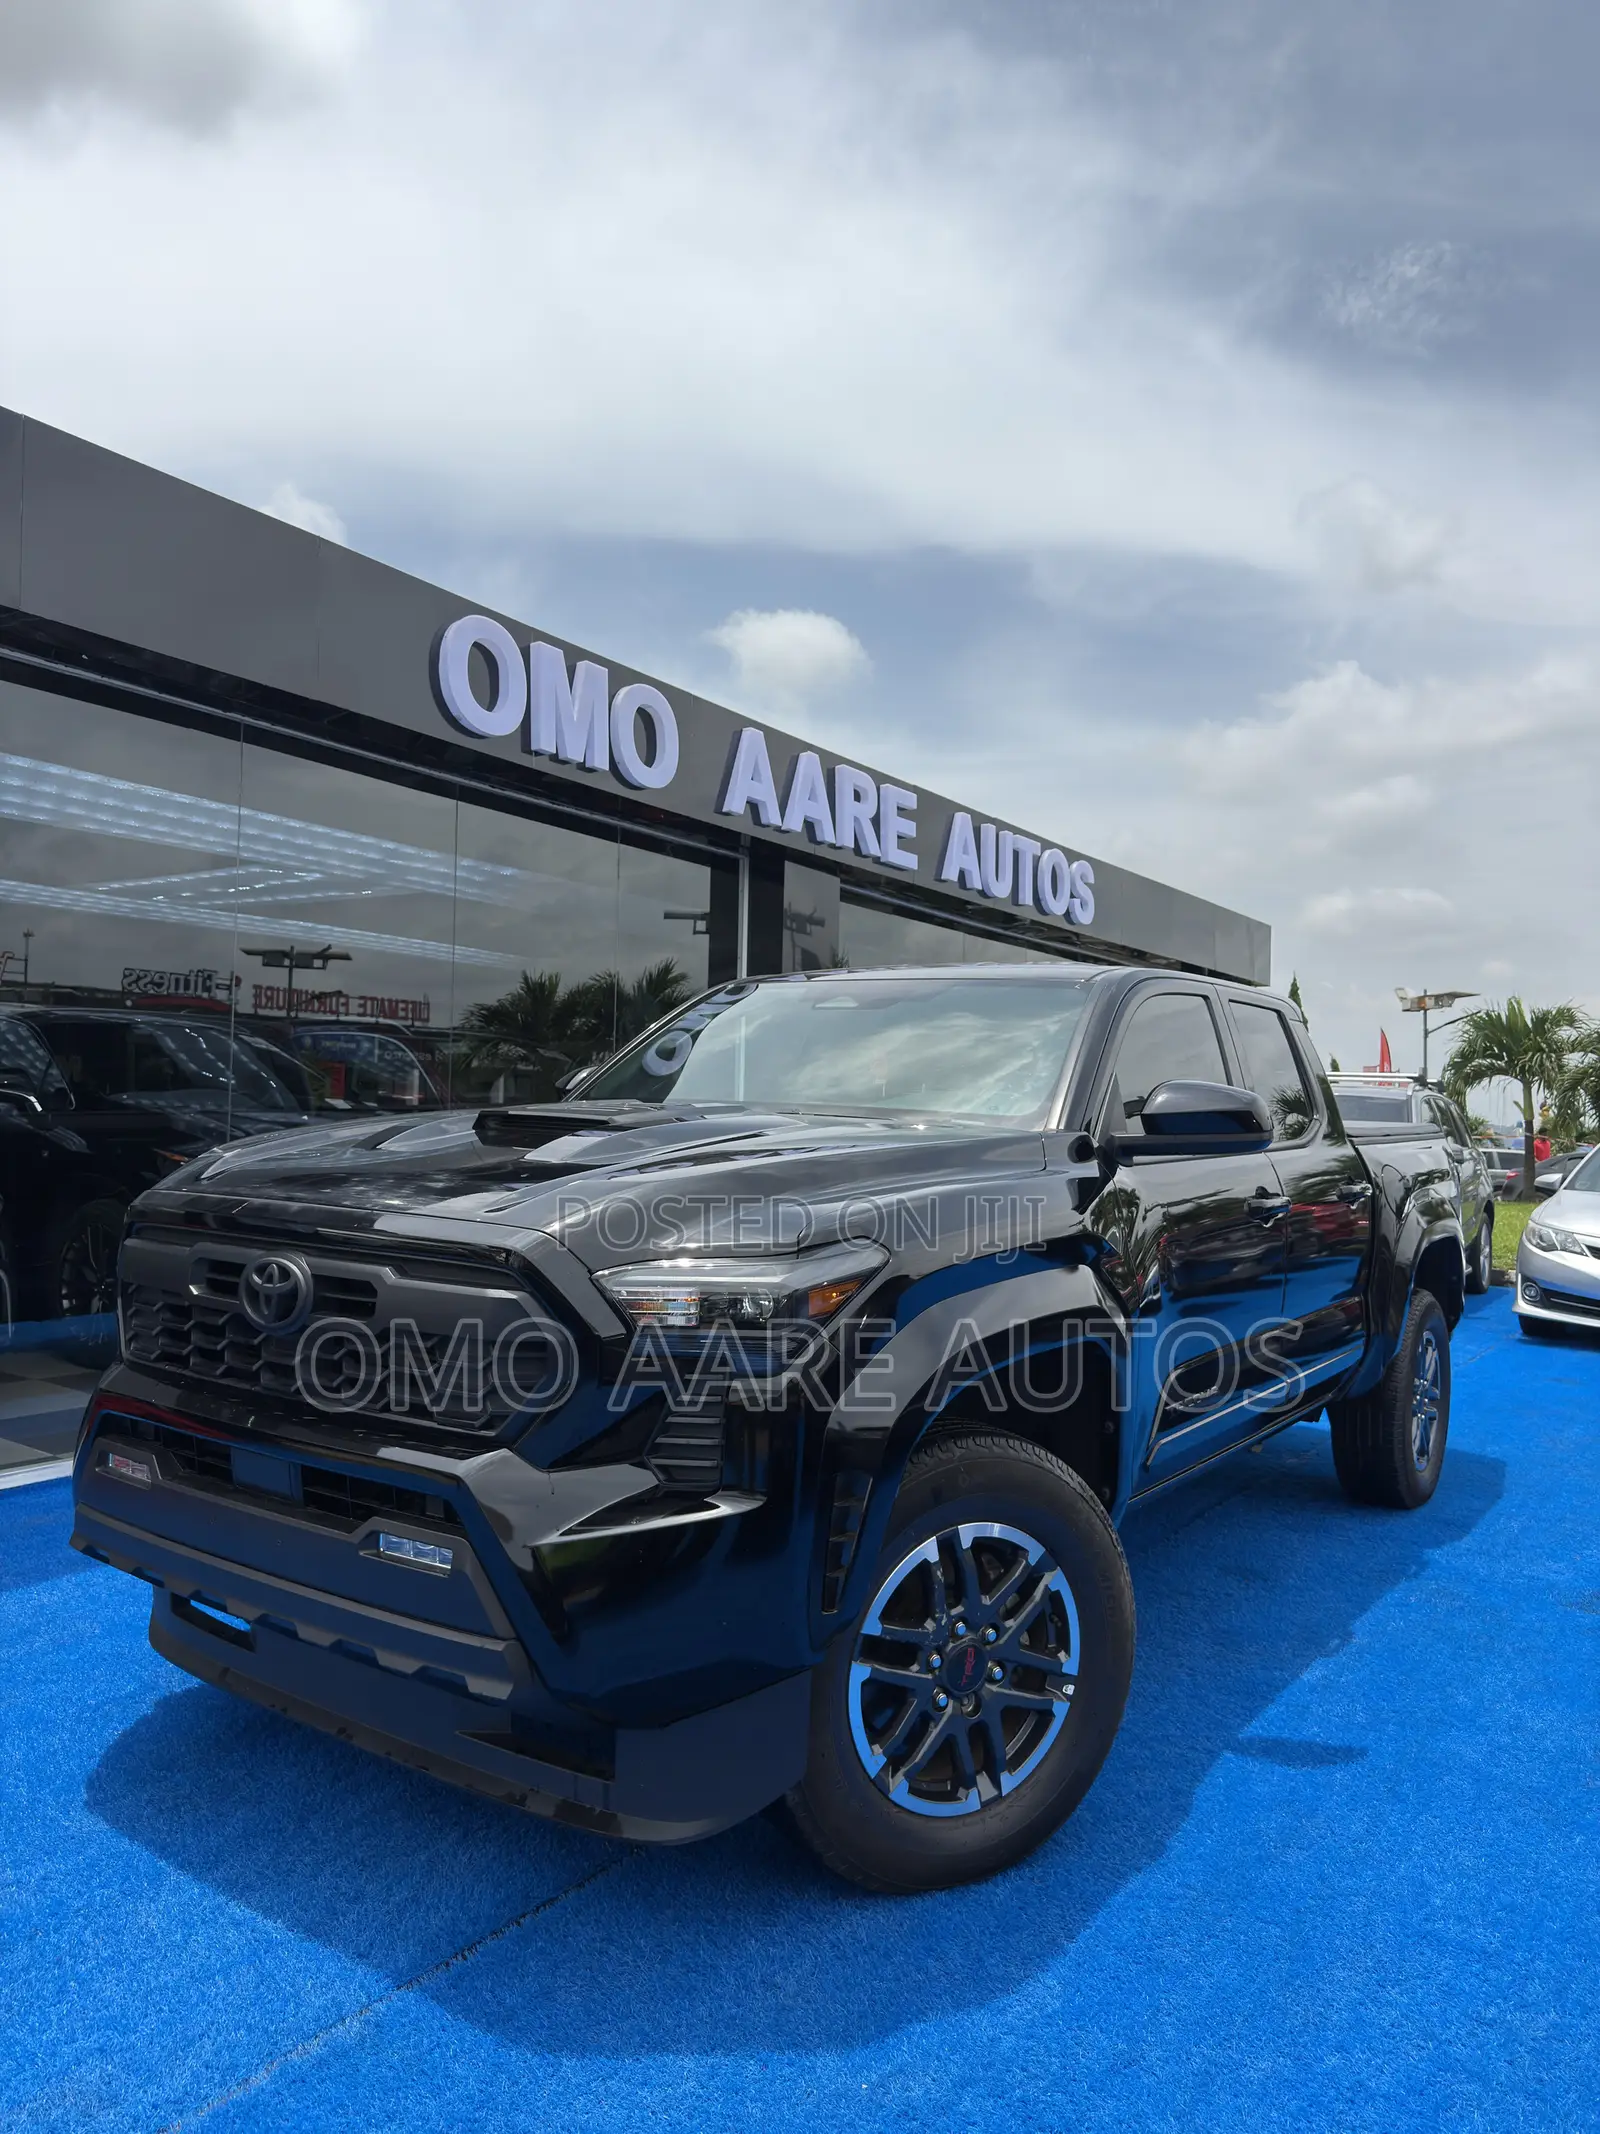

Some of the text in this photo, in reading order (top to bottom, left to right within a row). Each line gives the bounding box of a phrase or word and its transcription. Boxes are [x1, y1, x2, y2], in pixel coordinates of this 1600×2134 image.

[436, 614, 1095, 926] OMO AARE AUTOS
